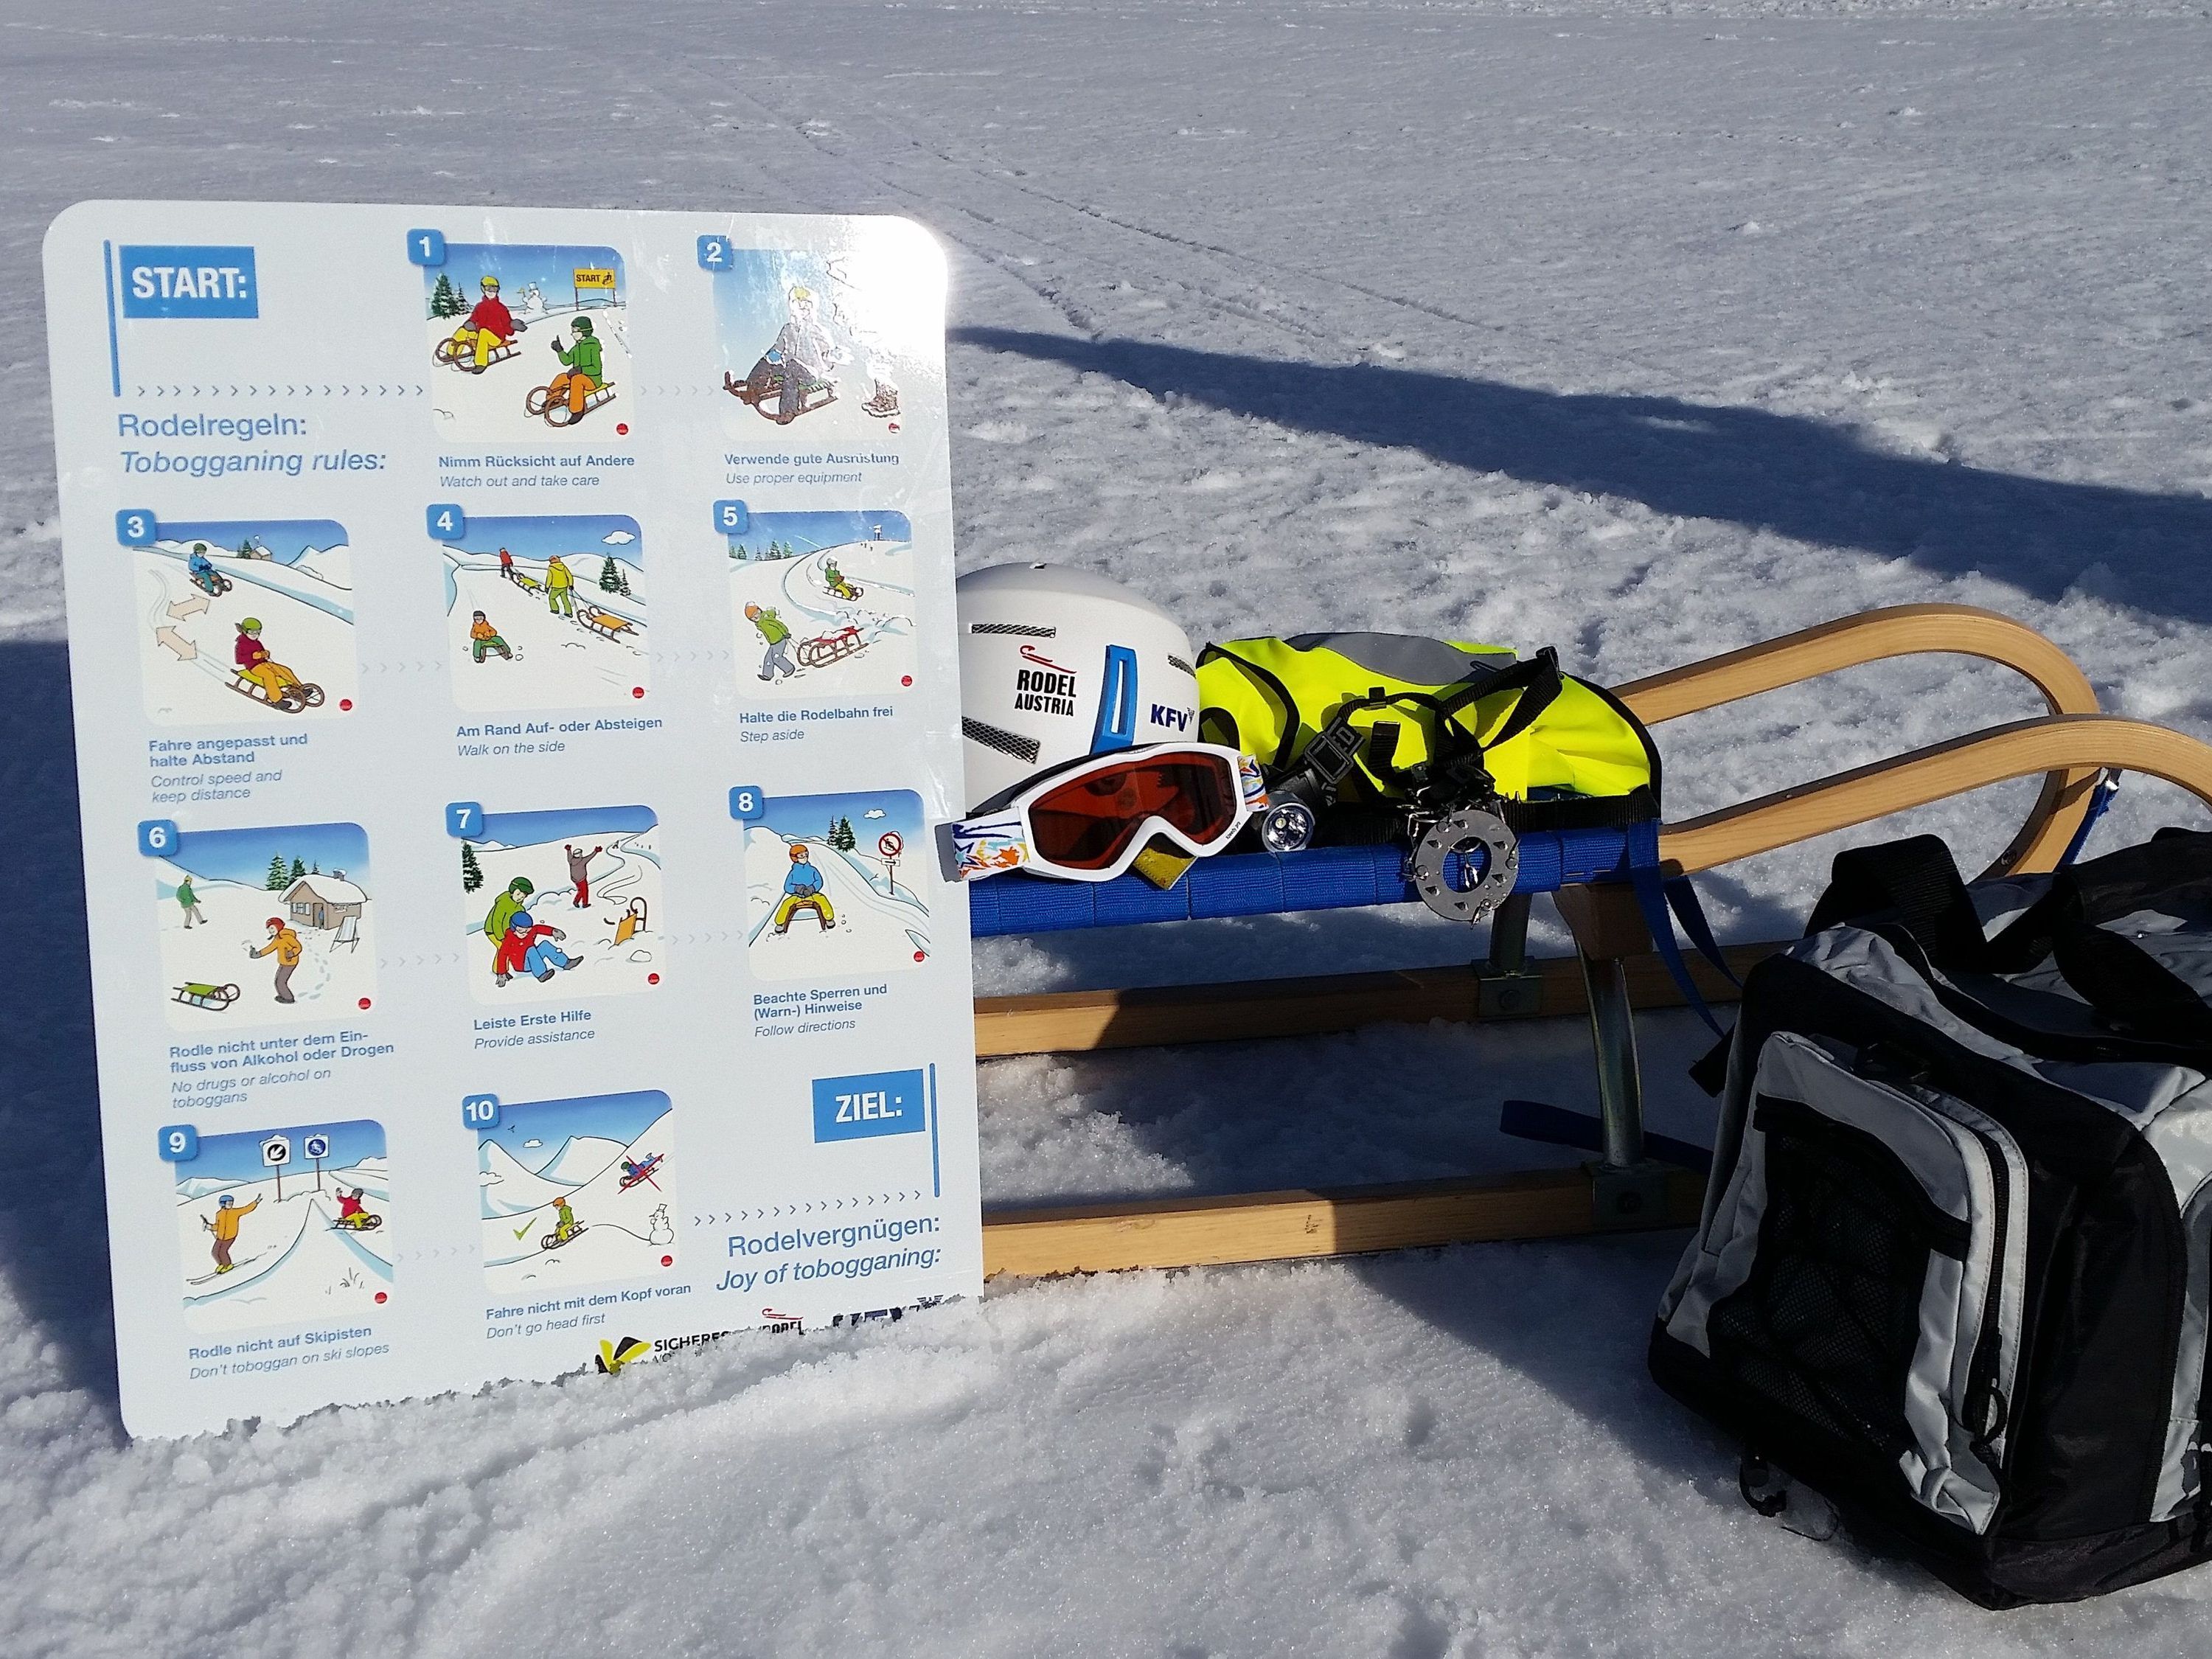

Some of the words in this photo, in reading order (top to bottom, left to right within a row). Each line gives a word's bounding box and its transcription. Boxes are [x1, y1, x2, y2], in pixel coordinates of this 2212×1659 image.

[419, 236, 431, 257] 1
[706, 243, 723, 262] 2
[132, 266, 247, 299] START:
[576, 274, 601, 283] START
[119, 413, 307, 441] Rodelregeln:
[122, 450, 303, 476] Tobogganing
[313, 449, 386, 471] rules:
[439, 456, 481, 467] Nimm
[485, 455, 557, 467] Rücksicht
[560, 455, 582, 467] auf
[585, 455, 635, 467] Andere
[725, 453, 790, 465] Verwende
[793, 453, 823, 467] gute
[826, 453, 900, 465] Ausrüstung
[439, 476, 481, 487] Watch
[486, 476, 508, 487] out
[512, 476, 537, 487] and
[541, 476, 568, 487] take
[571, 476, 599, 486] care
[726, 473, 750, 484] Use
[754, 473, 795, 486] proper
[799, 472, 862, 485] equipment
[437, 511, 453, 531] 4
[723, 507, 737, 526] 5
[128, 518, 144, 538] 3
[1017, 669, 1077, 698] RODEL
[740, 712, 773, 724] Halte
[777, 711, 797, 723] die
[801, 708, 869, 721] Rodelbahn
[872, 706, 894, 717] frei
[1015, 693, 1074, 717] AUSTRIA
[456, 726, 480, 737] Am
[484, 724, 522, 736] Rand
[525, 721, 555, 734] Auf-
[559, 720, 591, 733] oder
[594, 717, 663, 731] Absteigen
[1150, 703, 1189, 733] KFV
[149, 740, 192, 752] Fahre
[197, 735, 276, 751] angepasst
[280, 734, 307, 745] und
[740, 731, 769, 744] Step
[772, 729, 805, 741] aside
[150, 755, 187, 768] halte
[192, 751, 255, 765] Abstand
[458, 745, 489, 757] Walk
[493, 744, 509, 755] on
[515, 742, 535, 754] the
[538, 741, 566, 753] side
[151, 773, 204, 788] Control
[208, 771, 251, 787] speed
[255, 770, 282, 782] and
[152, 791, 187, 804] keep
[191, 787, 251, 801] distance
[738, 792, 754, 812] 8
[456, 809, 471, 830] 7
[149, 827, 167, 848] 6
[754, 991, 807, 1005] Beachte
[810, 988, 860, 1002] Sperren
[864, 984, 888, 995] und
[474, 1019, 516, 1031] Leiste
[521, 1014, 557, 1027] Erste
[560, 1009, 592, 1023] Hilfe
[754, 1006, 801, 1021] (Warn-)
[804, 1001, 863, 1015] Hinweise
[755, 1024, 794, 1037] Follow
[798, 1019, 856, 1034] directions
[170, 1046, 214, 1059] Rodle
[218, 1040, 256, 1054] nicht
[260, 1037, 299, 1051] unter
[303, 1034, 335, 1046] dem
[340, 1030, 369, 1043] Ein-
[474, 1035, 524, 1050] Provide
[528, 1029, 596, 1045] assistance
[170, 1060, 206, 1074] fluss
[211, 1057, 238, 1069] von
[242, 1052, 298, 1067] Alkohol
[303, 1048, 336, 1062] oder
[341, 1043, 394, 1059] Drogen
[171, 1081, 192, 1094] No
[196, 1077, 237, 1092] drugs
[241, 1077, 256, 1087] or
[260, 1070, 310, 1085] alcohol
[313, 1069, 331, 1080] on
[173, 1092, 248, 1109] toboggans
[466, 1101, 494, 1121] 10
[835, 1091, 902, 1124] ZIEL:
[169, 1132, 187, 1153] 9
[728, 1217, 940, 1257] Rodelvergnügen:
[716, 1270, 757, 1293] Joy
[764, 1262, 789, 1285] of
[793, 1248, 942, 1281] tobogganing:
[486, 1307, 524, 1320] Fahre
[528, 1301, 562, 1315] nicht
[564, 1297, 585, 1310] mit
[588, 1293, 618, 1307] dem
[621, 1287, 653, 1303] Kopf
[655, 1285, 692, 1298] voran
[487, 1324, 523, 1339] Don't
[526, 1324, 543, 1336] go
[546, 1316, 578, 1331] head
[582, 1313, 605, 1326] first
[189, 1345, 232, 1360] Rodle
[237, 1339, 274, 1354] nicht
[278, 1335, 301, 1349] auf
[305, 1327, 372, 1345] Skipisten
[189, 1364, 228, 1380] Don't
[232, 1356, 298, 1374] toboggan
[302, 1353, 319, 1364] on
[324, 1349, 342, 1362] ski
[345, 1343, 390, 1359] slopes
